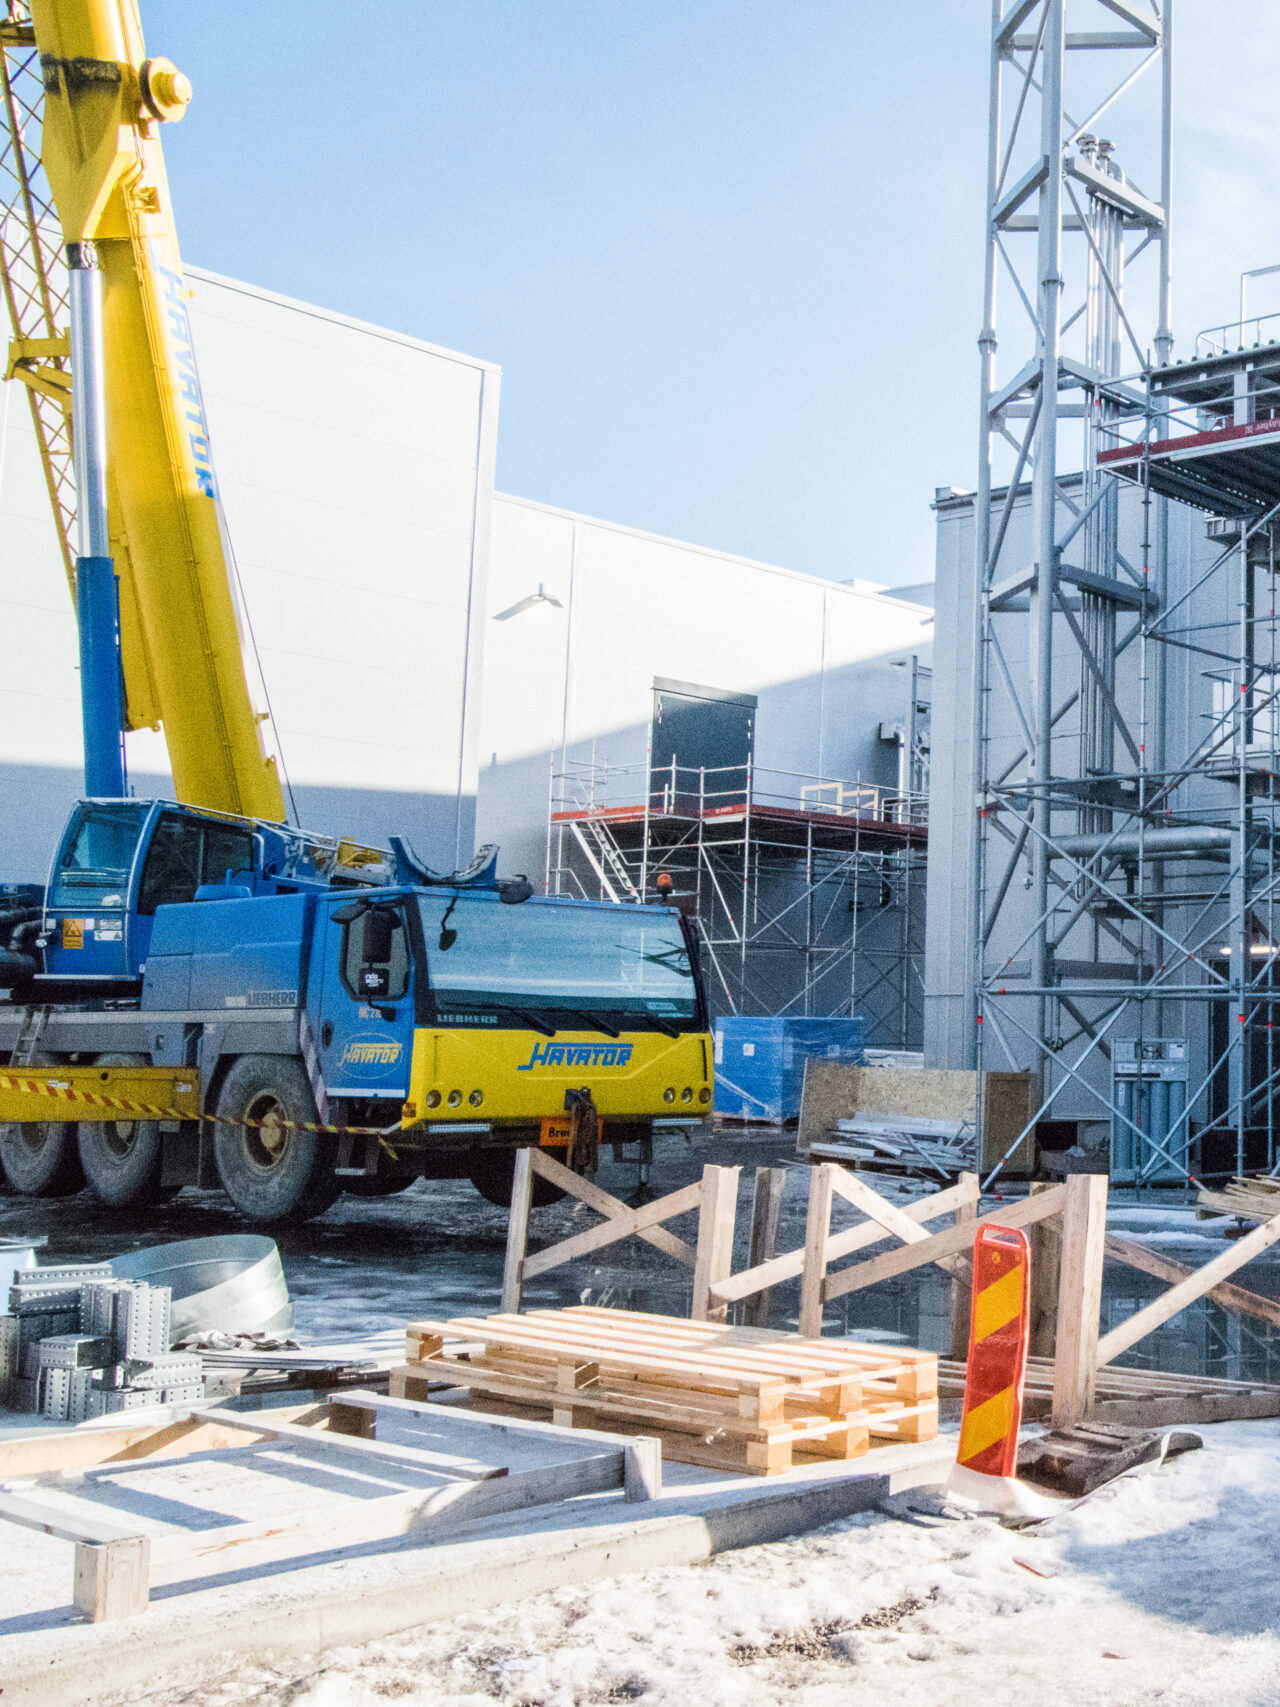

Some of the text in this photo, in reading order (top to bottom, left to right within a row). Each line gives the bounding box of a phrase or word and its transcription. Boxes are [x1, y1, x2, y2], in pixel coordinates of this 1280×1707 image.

[437, 1014, 498, 1024] LIEBHERR
[337, 1043, 403, 1067] HAVATOR
[517, 1042, 634, 1071] HAVATOR
